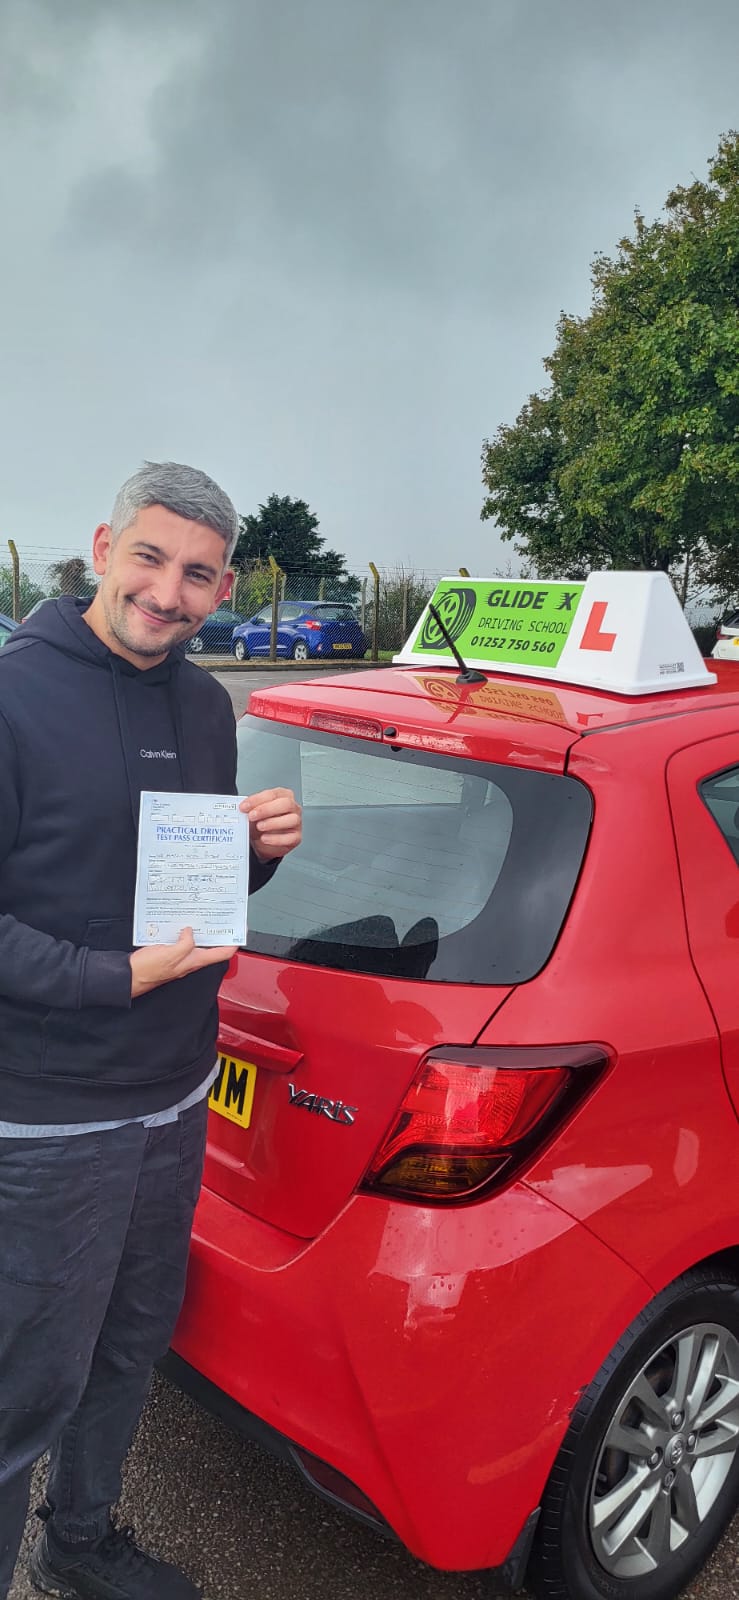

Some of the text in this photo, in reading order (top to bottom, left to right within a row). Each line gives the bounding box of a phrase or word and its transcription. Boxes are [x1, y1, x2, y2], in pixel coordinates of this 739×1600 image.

[484, 589, 578, 611] GLIDE X
[478, 617, 568, 634] DRIVING SCHOOL
[579, 601, 617, 652] L
[470, 635, 556, 653] 01252 750 560
[140, 749, 177, 759] Calvin Klein
[156, 825, 234, 836] PRACTICAL DRIVING
[157, 833, 233, 843] TEST PASS CERTIFICATE
